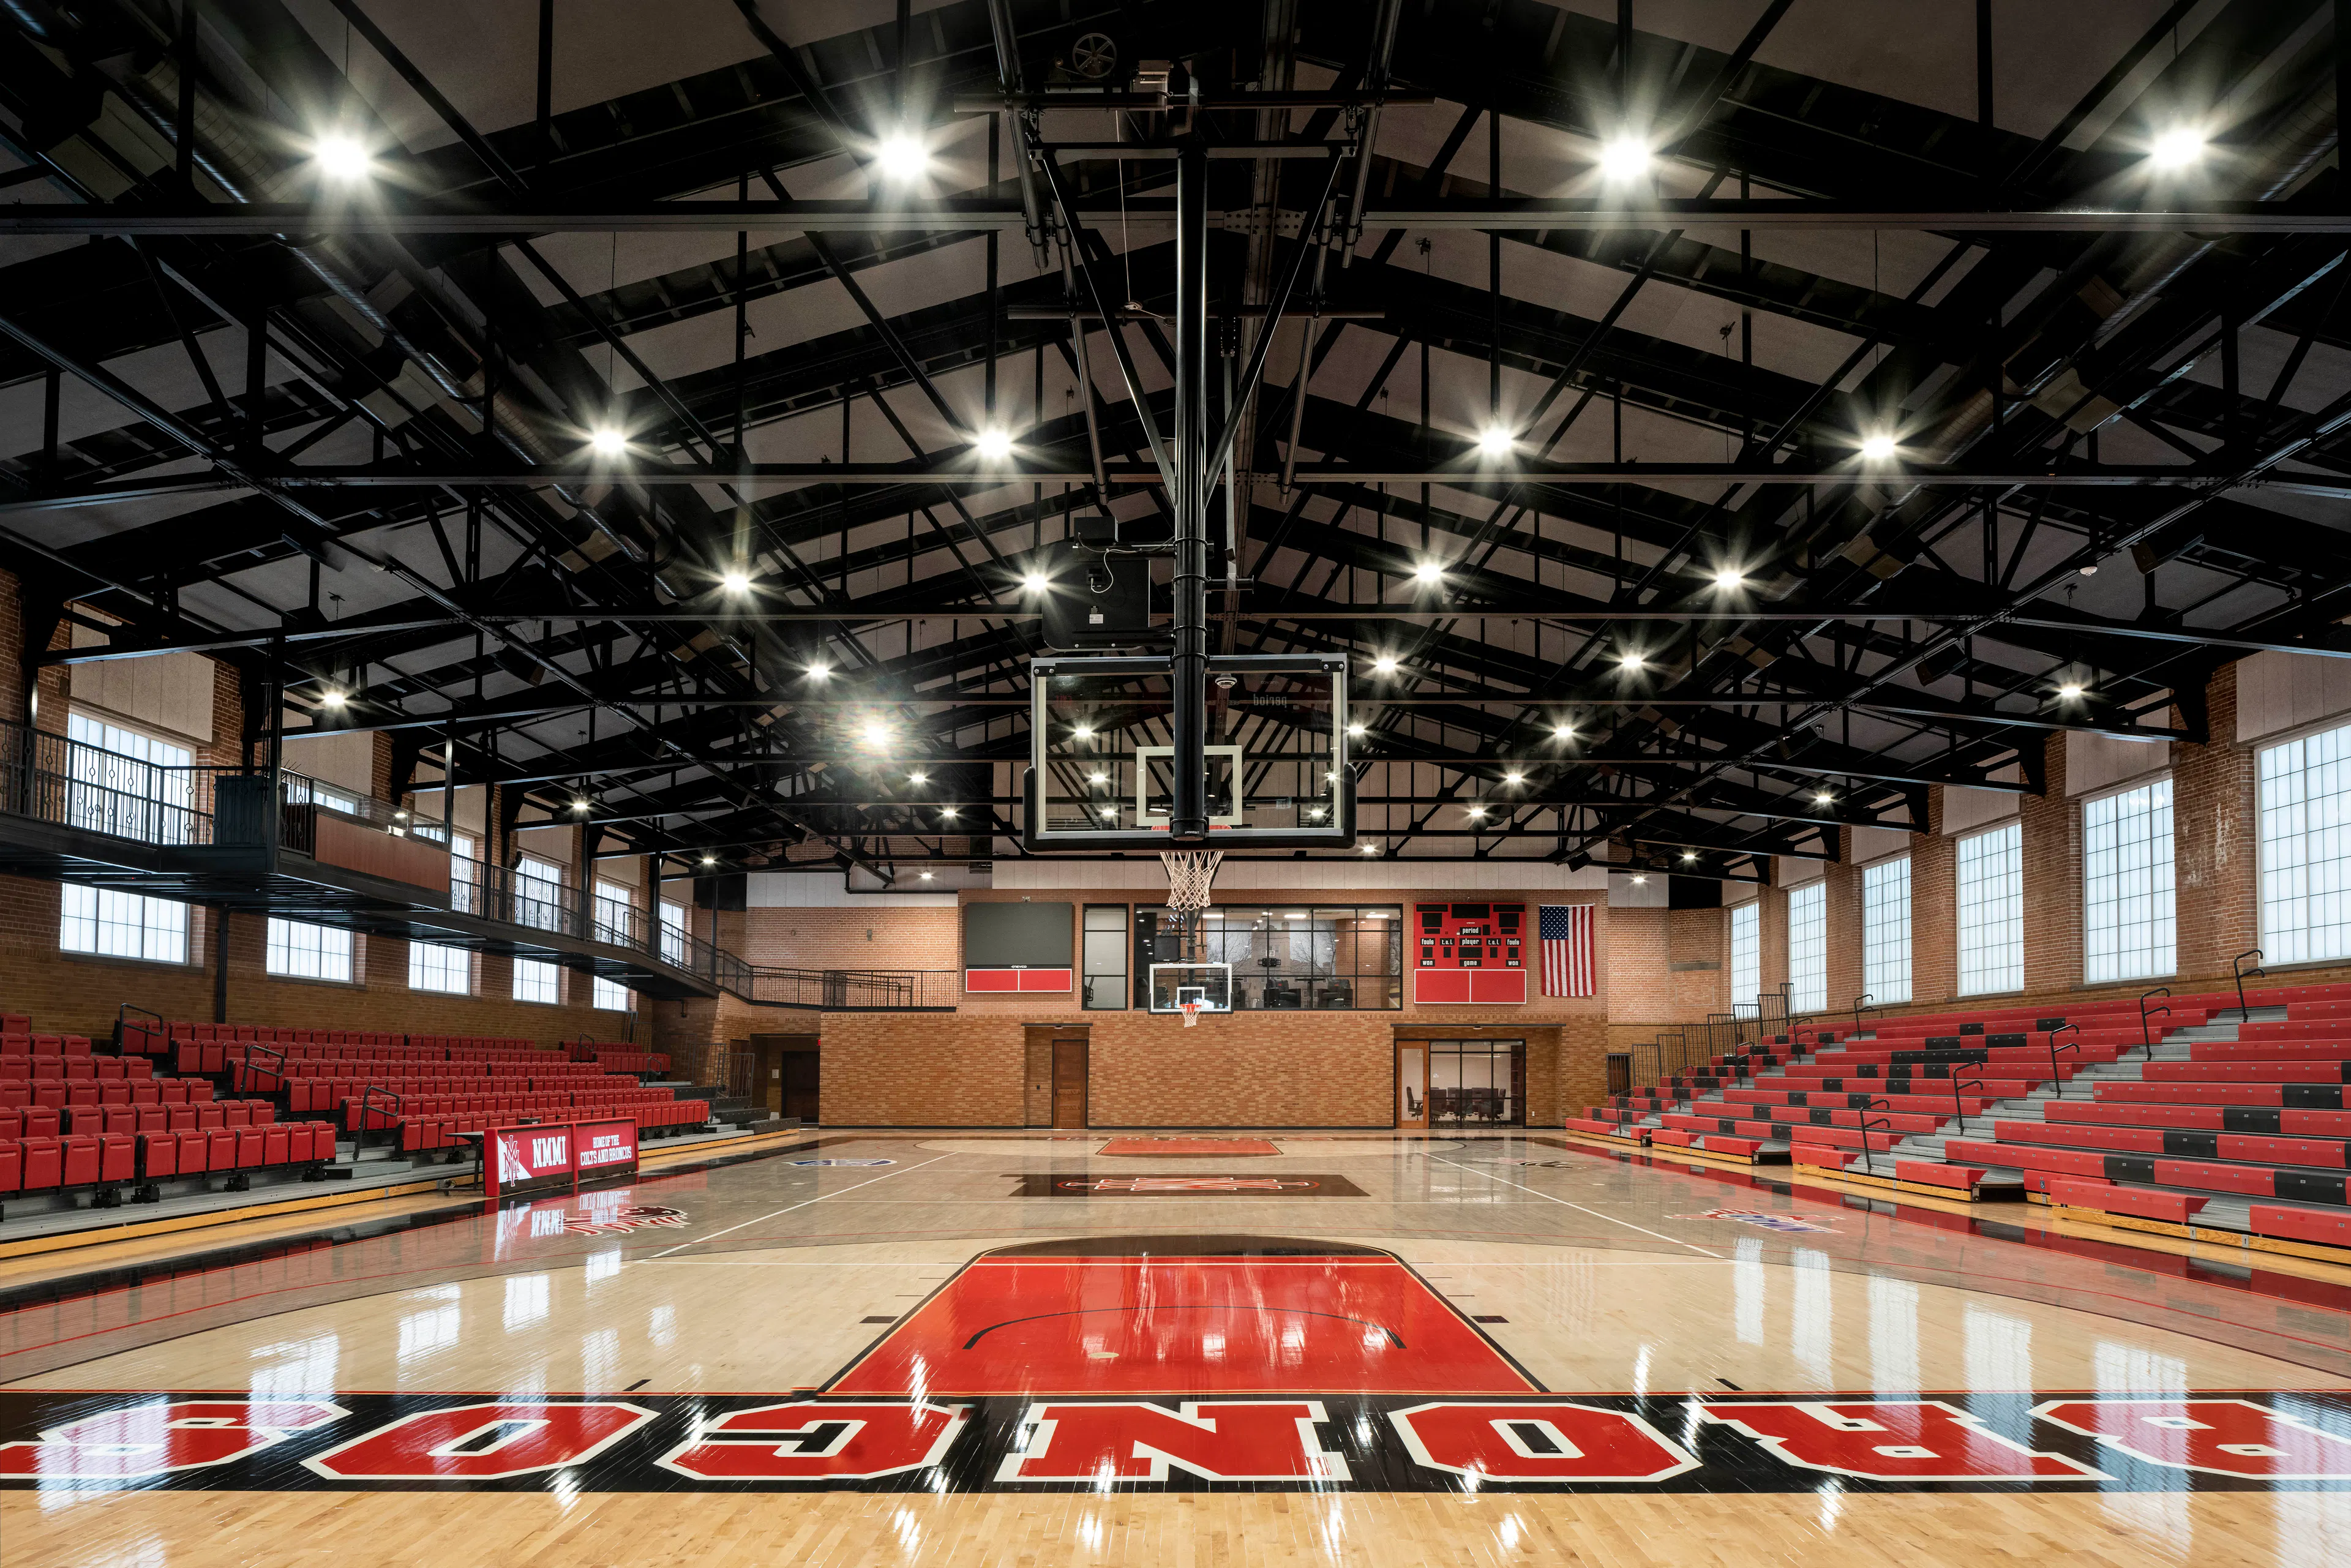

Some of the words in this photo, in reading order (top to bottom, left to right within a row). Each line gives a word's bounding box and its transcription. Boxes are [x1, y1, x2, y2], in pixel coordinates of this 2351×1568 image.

[532, 1136, 567, 1168] NMMI
[593, 1136, 606, 1149] HOME
[606, 1135, 610, 1147] OF
[610, 1135, 620, 1146] THE
[580, 1150, 598, 1166] COLTS
[598, 1148, 609, 1163] AND
[609, 1146, 632, 1162] BRONCOS
